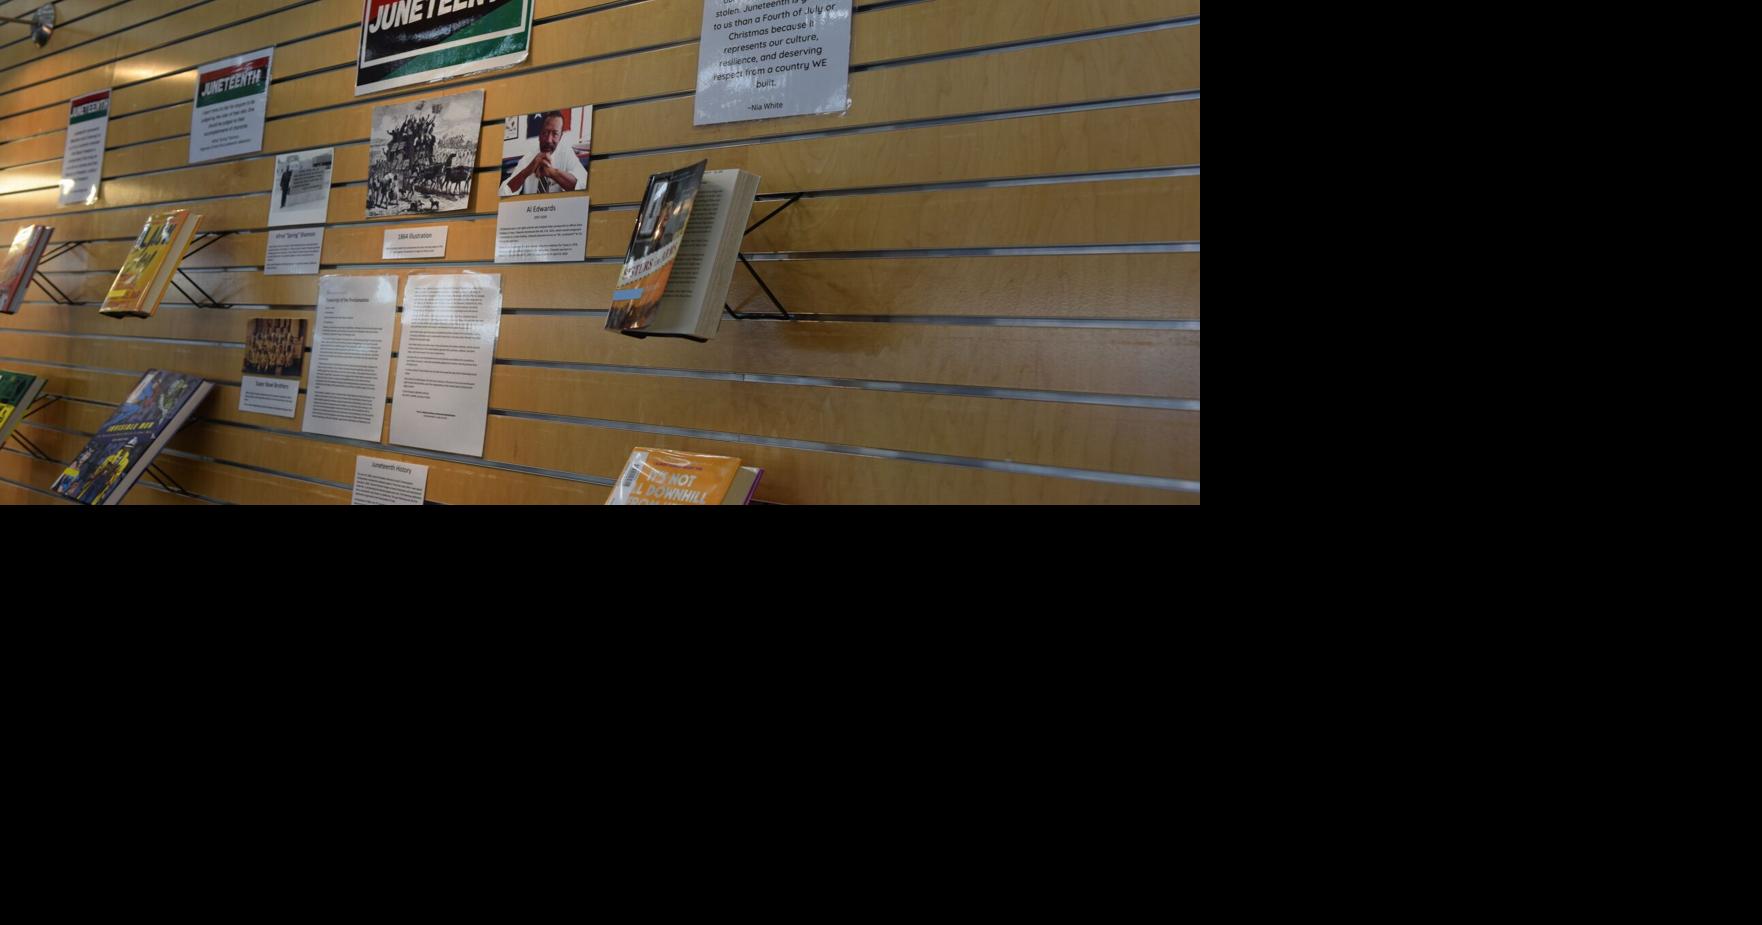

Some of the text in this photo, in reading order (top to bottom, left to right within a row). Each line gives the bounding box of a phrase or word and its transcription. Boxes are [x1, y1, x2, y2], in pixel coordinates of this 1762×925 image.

[713, 23, 722, 31] to
[723, 21, 733, 29] us
[734, 17, 753, 27] than
[762, 11, 790, 22] Fourth
[792, 7, 802, 17] of
[804, 4, 823, 15] July
[825, 3, 836, 11] or
[728, 20, 815, 41] Christmas because it
[723, 33, 819, 55] represents our culture,
[719, 45, 823, 68] resilience, and deserving
[713, 58, 828, 81] respect from a country WE
[201, 69, 262, 97] JUNETEENTH
[756, 79, 777, 89] built.
[763, 101, 784, 111] White
[526, 203, 556, 213] Al Edwards
[669, 474, 698, 487] NOT
[646, 485, 707, 503] DOWNHILL
